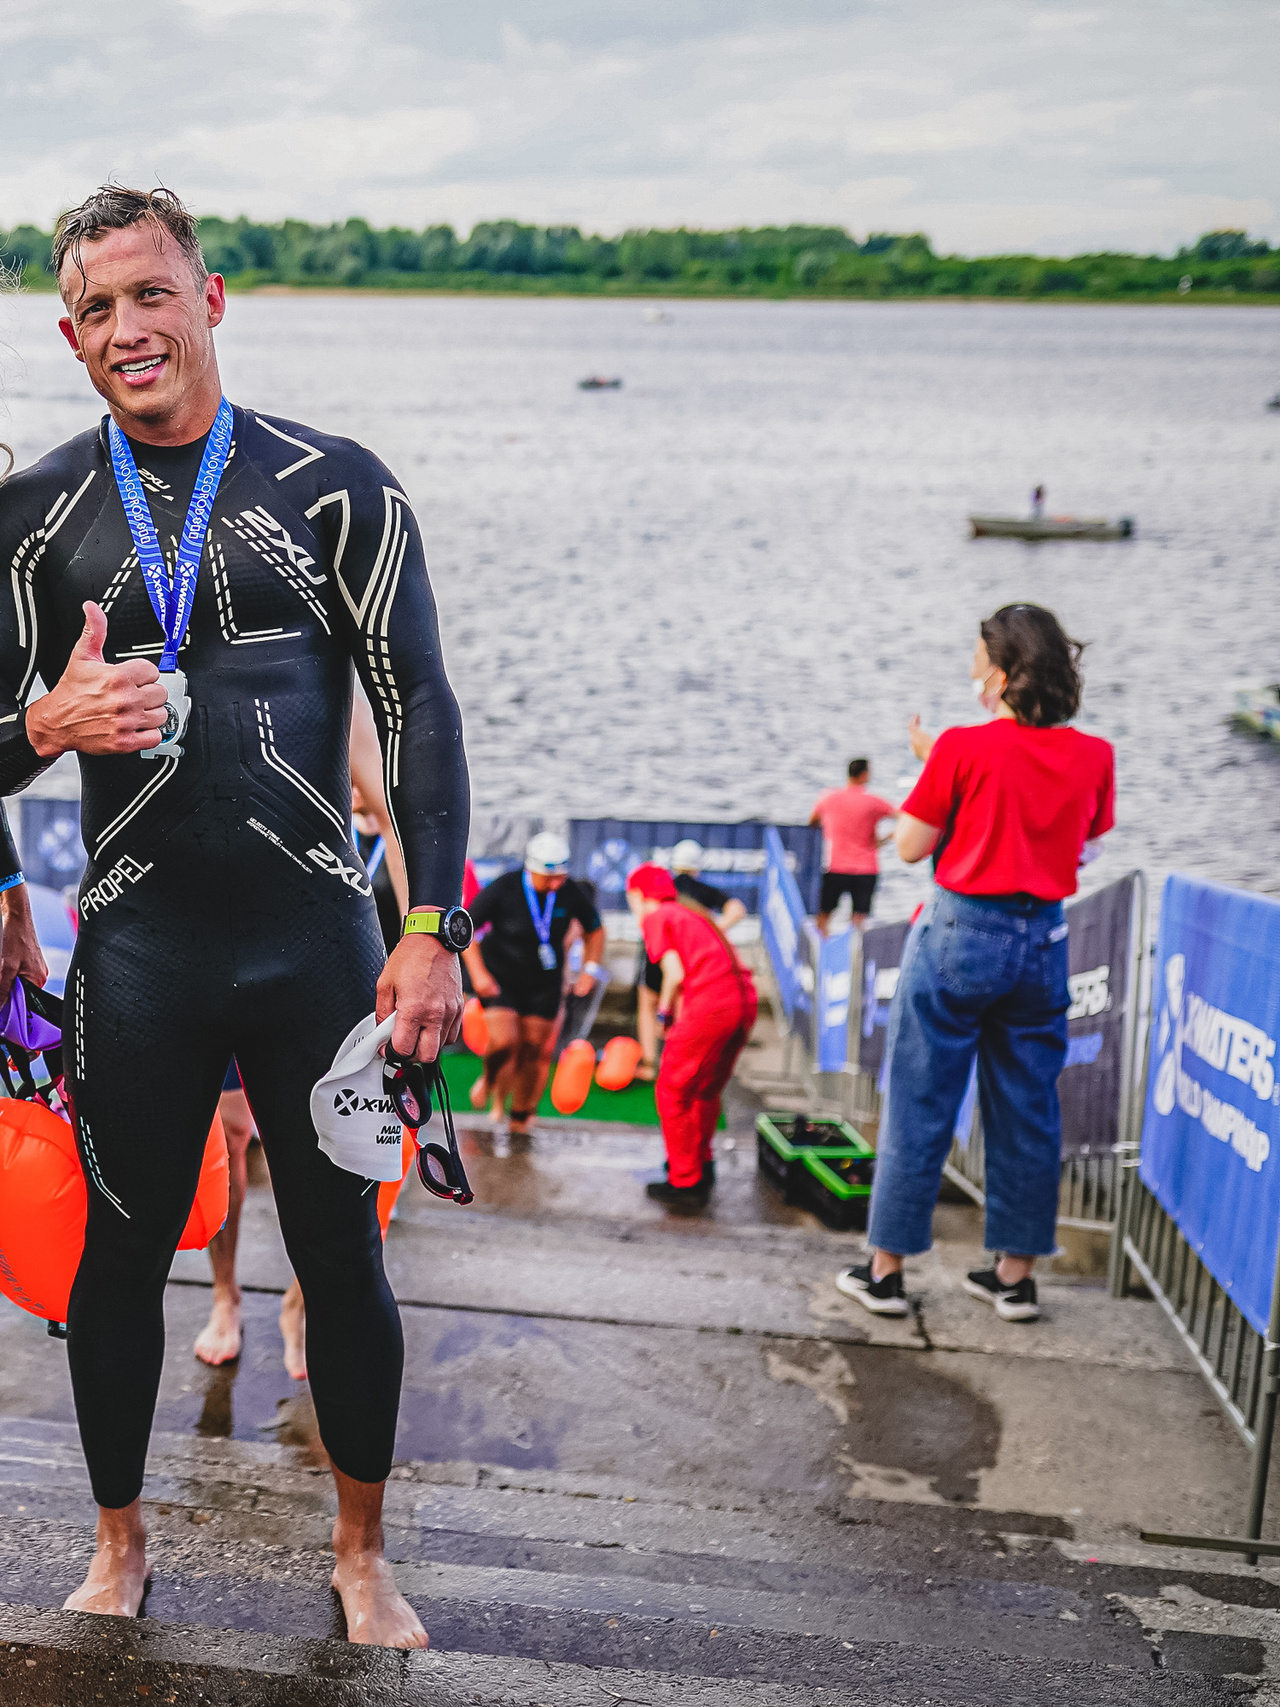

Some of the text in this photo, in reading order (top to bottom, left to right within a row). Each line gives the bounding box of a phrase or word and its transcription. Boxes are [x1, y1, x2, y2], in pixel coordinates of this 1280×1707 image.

[214, 409, 230, 450] NIZHNY
[118, 459, 144, 521] NOVGOROD
[195, 451, 221, 515] NOVGOROD
[239, 505, 328, 585] 2XU
[80, 854, 154, 921] PROPEL
[305, 842, 373, 897] 2XU
[376, 1135, 402, 1145] WAVE
[380, 1125, 402, 1135] MAD
